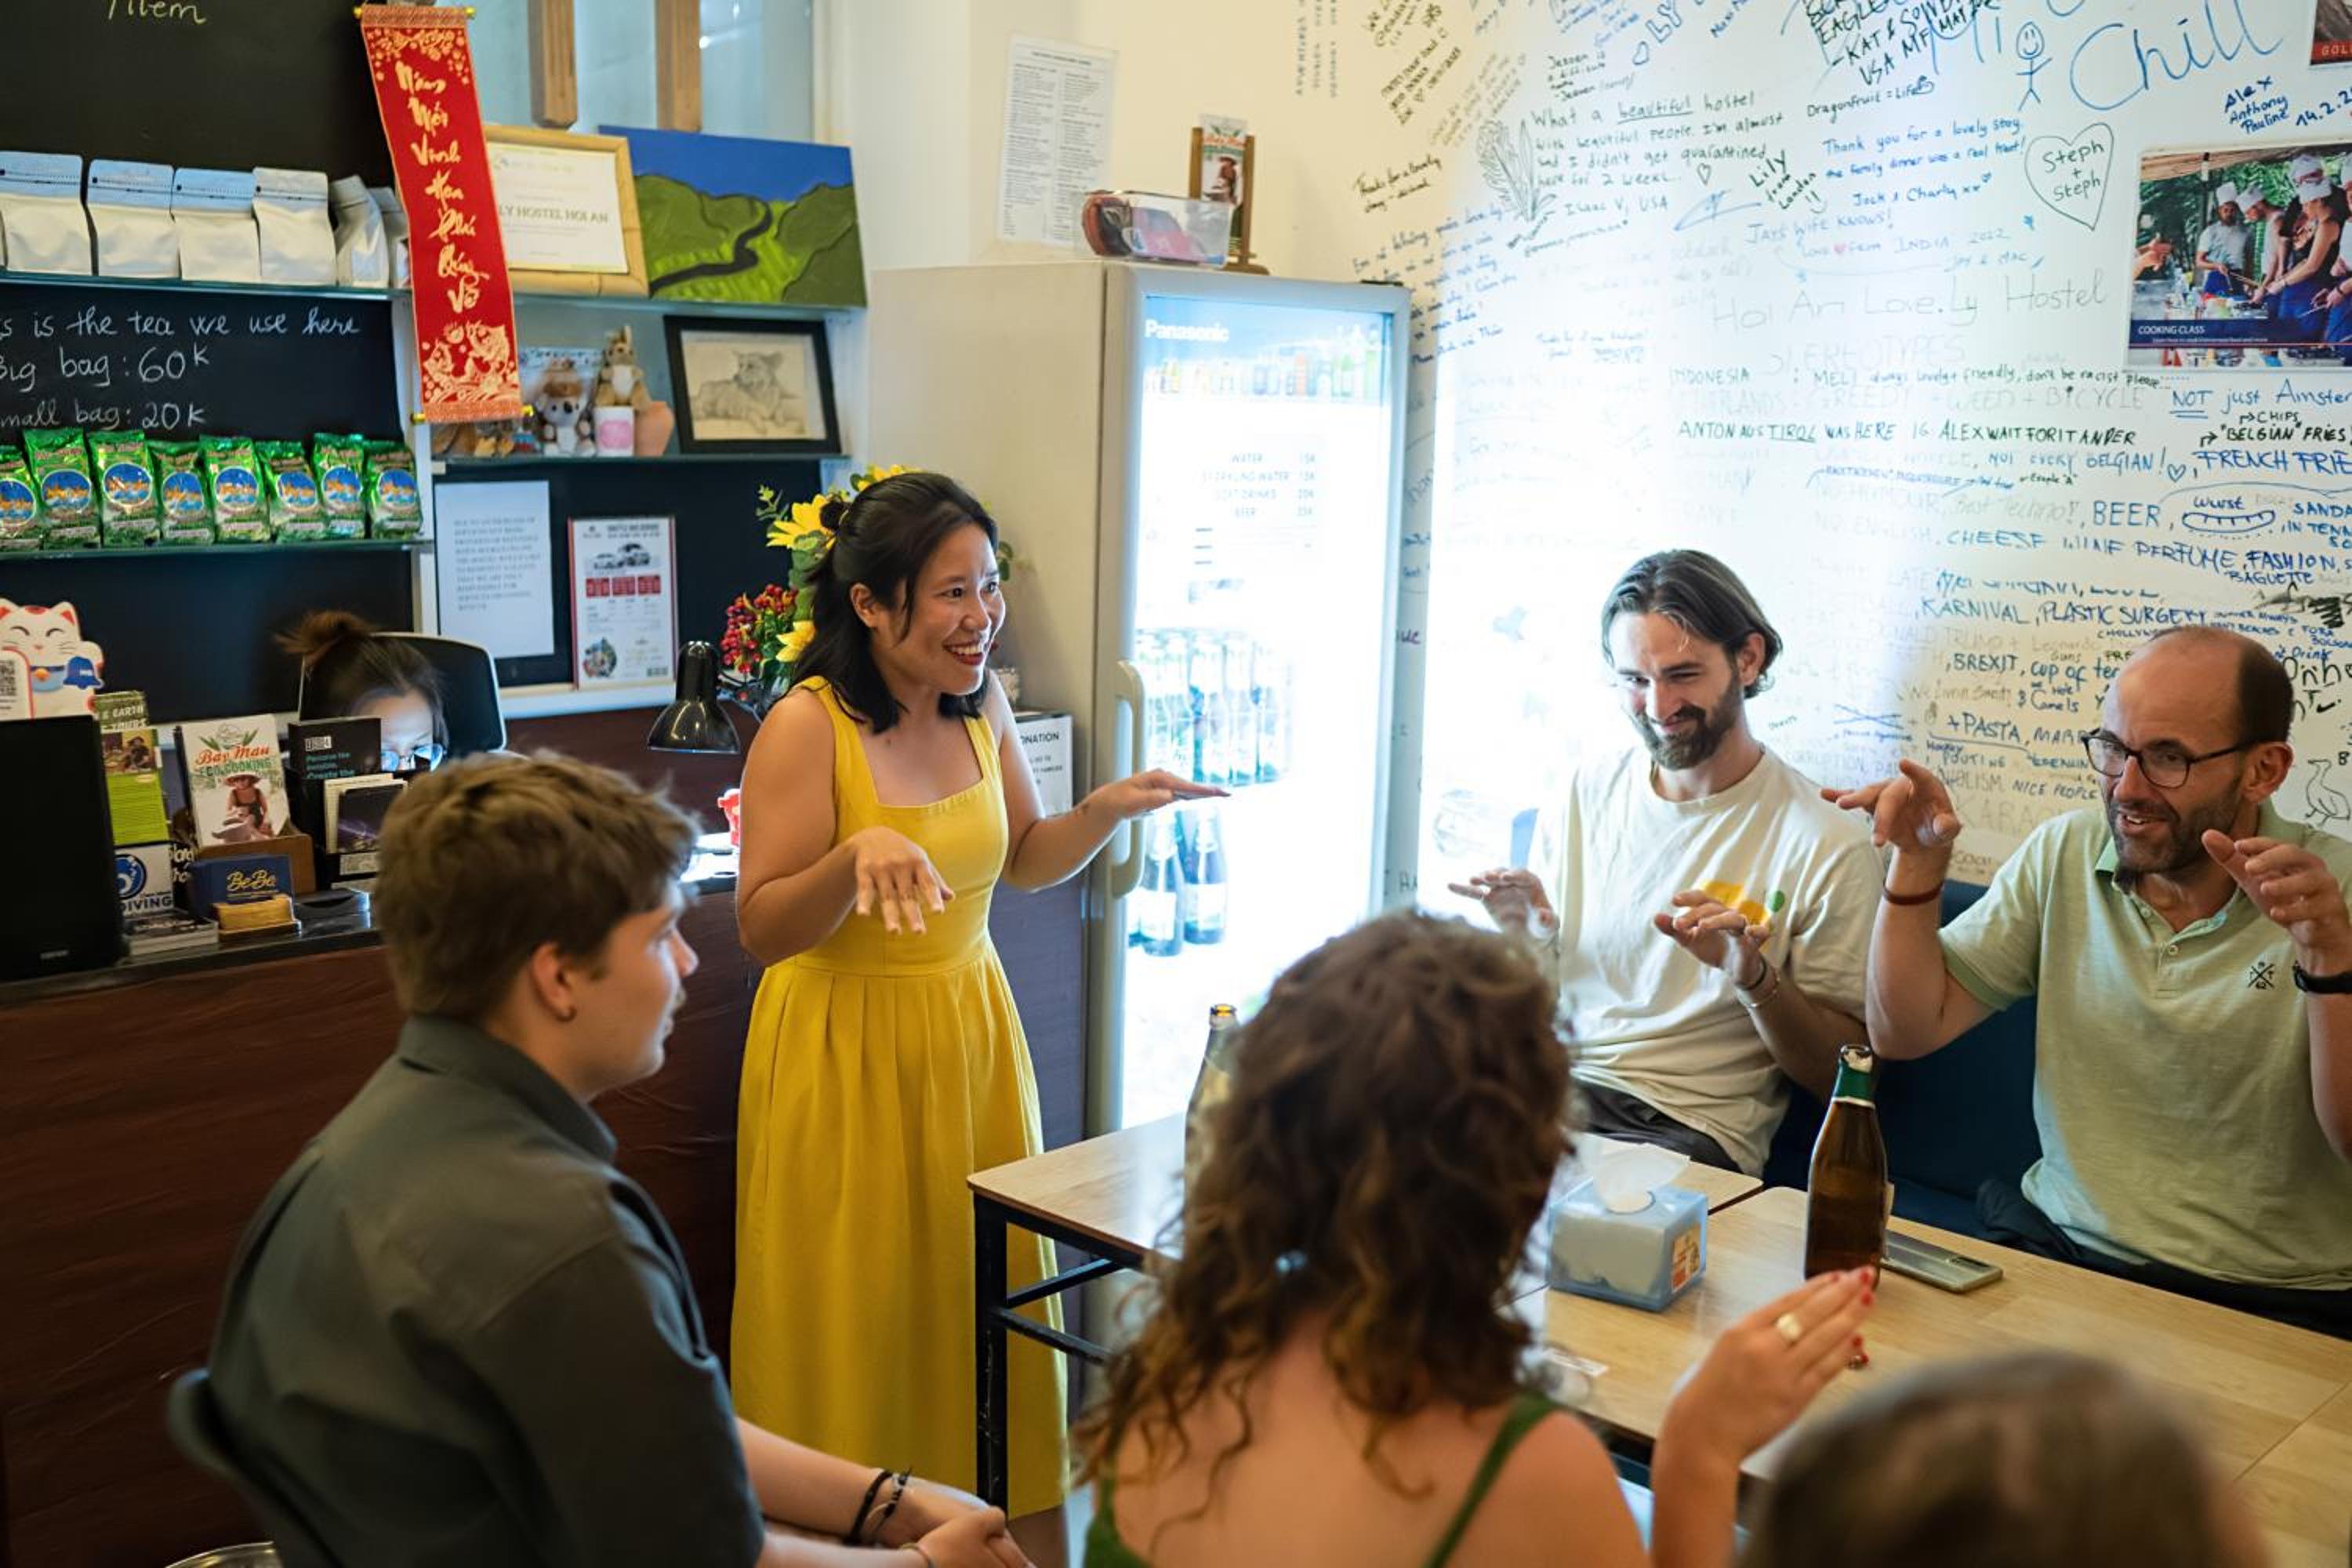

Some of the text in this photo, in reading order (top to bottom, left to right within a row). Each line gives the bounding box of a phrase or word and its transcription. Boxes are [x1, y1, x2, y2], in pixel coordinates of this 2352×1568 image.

[2230, 93, 2288, 124] Anthony
[2042, 141, 2104, 174] Steph
[2053, 173, 2101, 201] Steph
[2005, 268, 2107, 310] Hostel
[65, 305, 118, 336] the
[127, 311, 175, 336] tea
[190, 314, 230, 336] we
[249, 315, 288, 335] use
[303, 307, 361, 335] here
[1145, 318, 1230, 343] Panasonic
[2172, 390, 2213, 407] NOT
[2220, 388, 2259, 414] just
